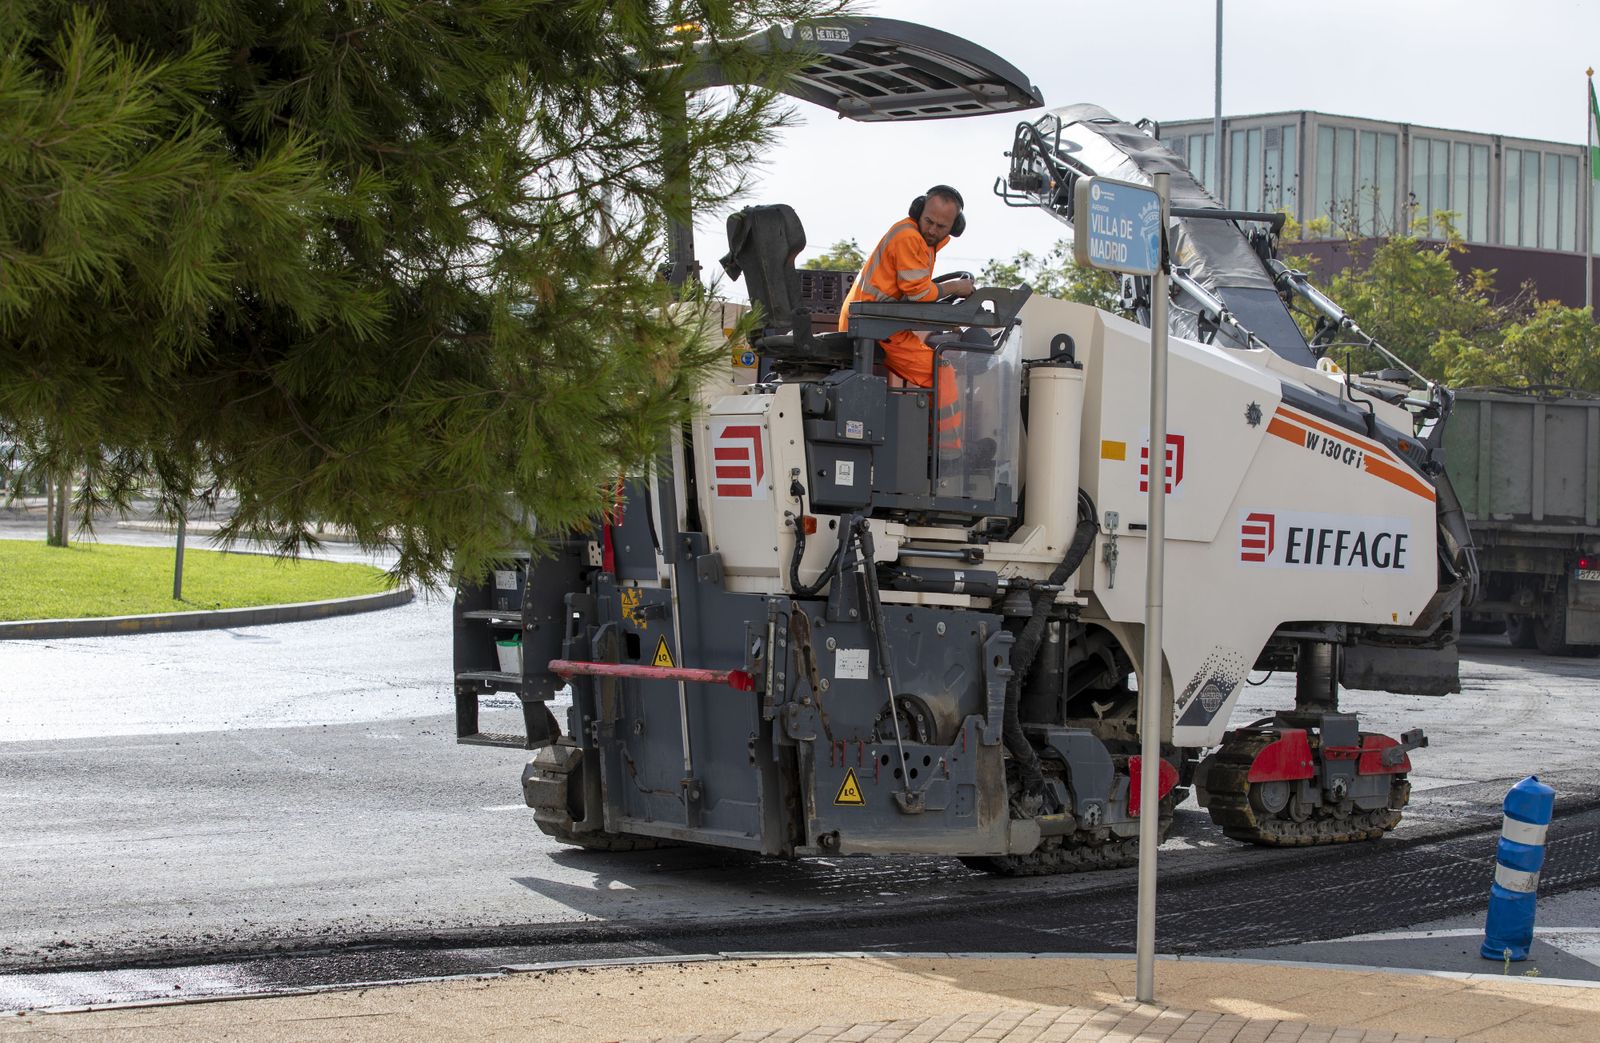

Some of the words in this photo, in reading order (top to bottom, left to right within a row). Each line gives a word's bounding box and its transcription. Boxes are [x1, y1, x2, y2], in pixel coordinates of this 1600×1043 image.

[1091, 213, 1119, 237] VILLA
[1120, 218, 1133, 240] DE
[1090, 238, 1128, 263] MADRID
[1306, 431, 1320, 451] W
[1321, 437, 1342, 460] 130
[1285, 526, 1408, 569] EIFFAGE
